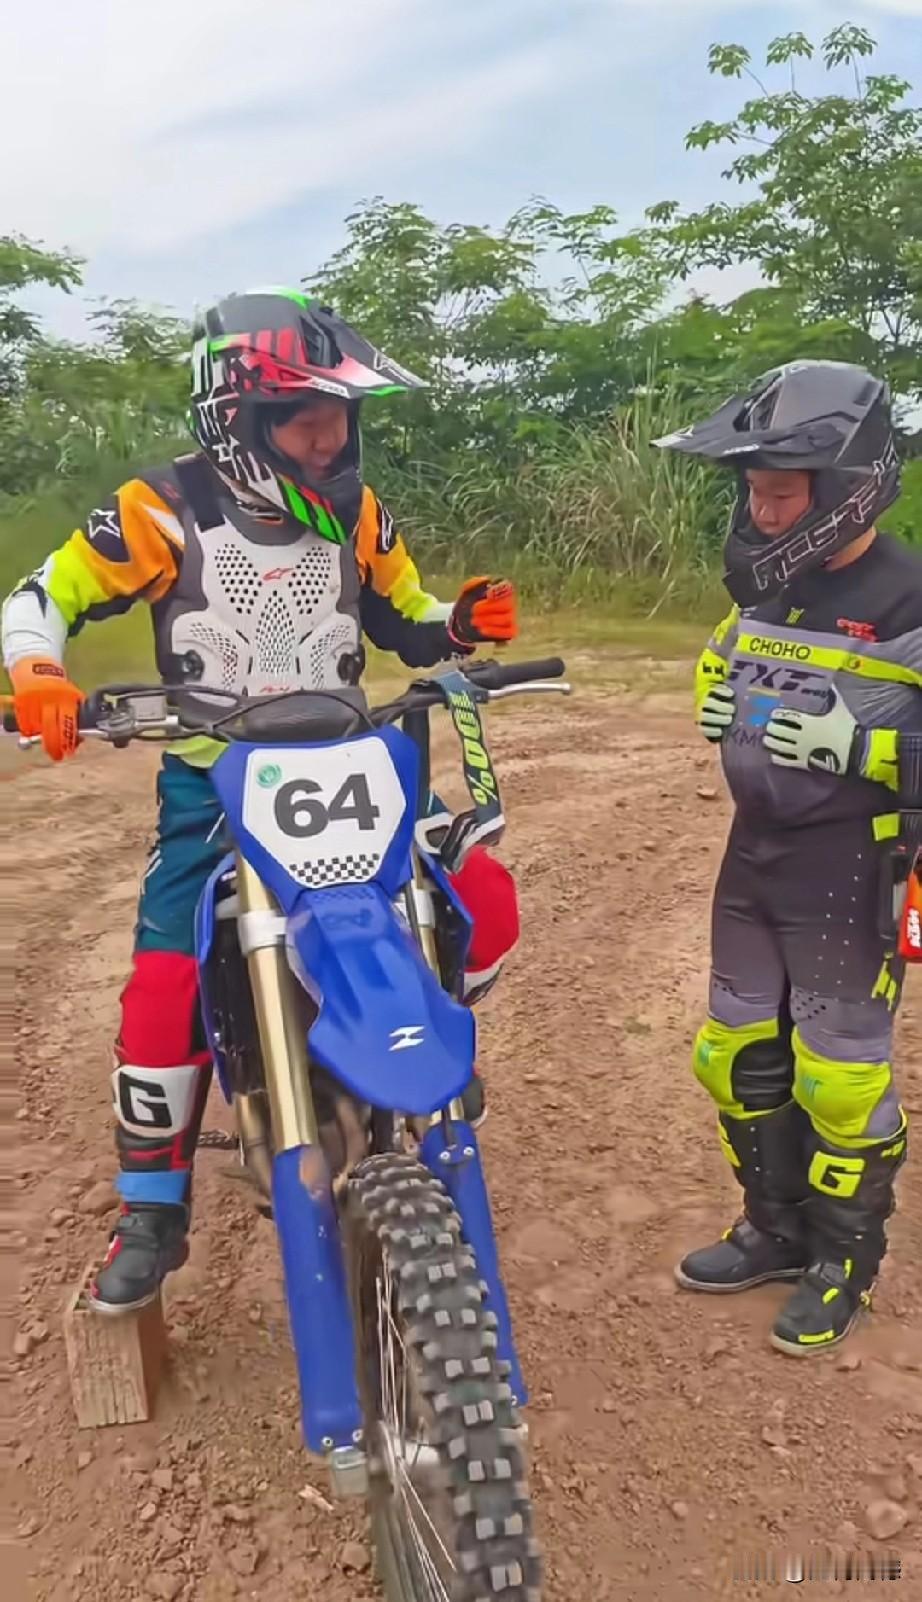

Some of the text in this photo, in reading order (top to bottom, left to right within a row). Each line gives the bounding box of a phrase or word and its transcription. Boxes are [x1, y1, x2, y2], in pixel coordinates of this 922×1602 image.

[750, 637, 811, 660] CHOHO
[449, 690, 498, 806] 100%
[274, 773, 380, 838] 64
[118, 1070, 173, 1128] G
[808, 1150, 865, 1197] G
